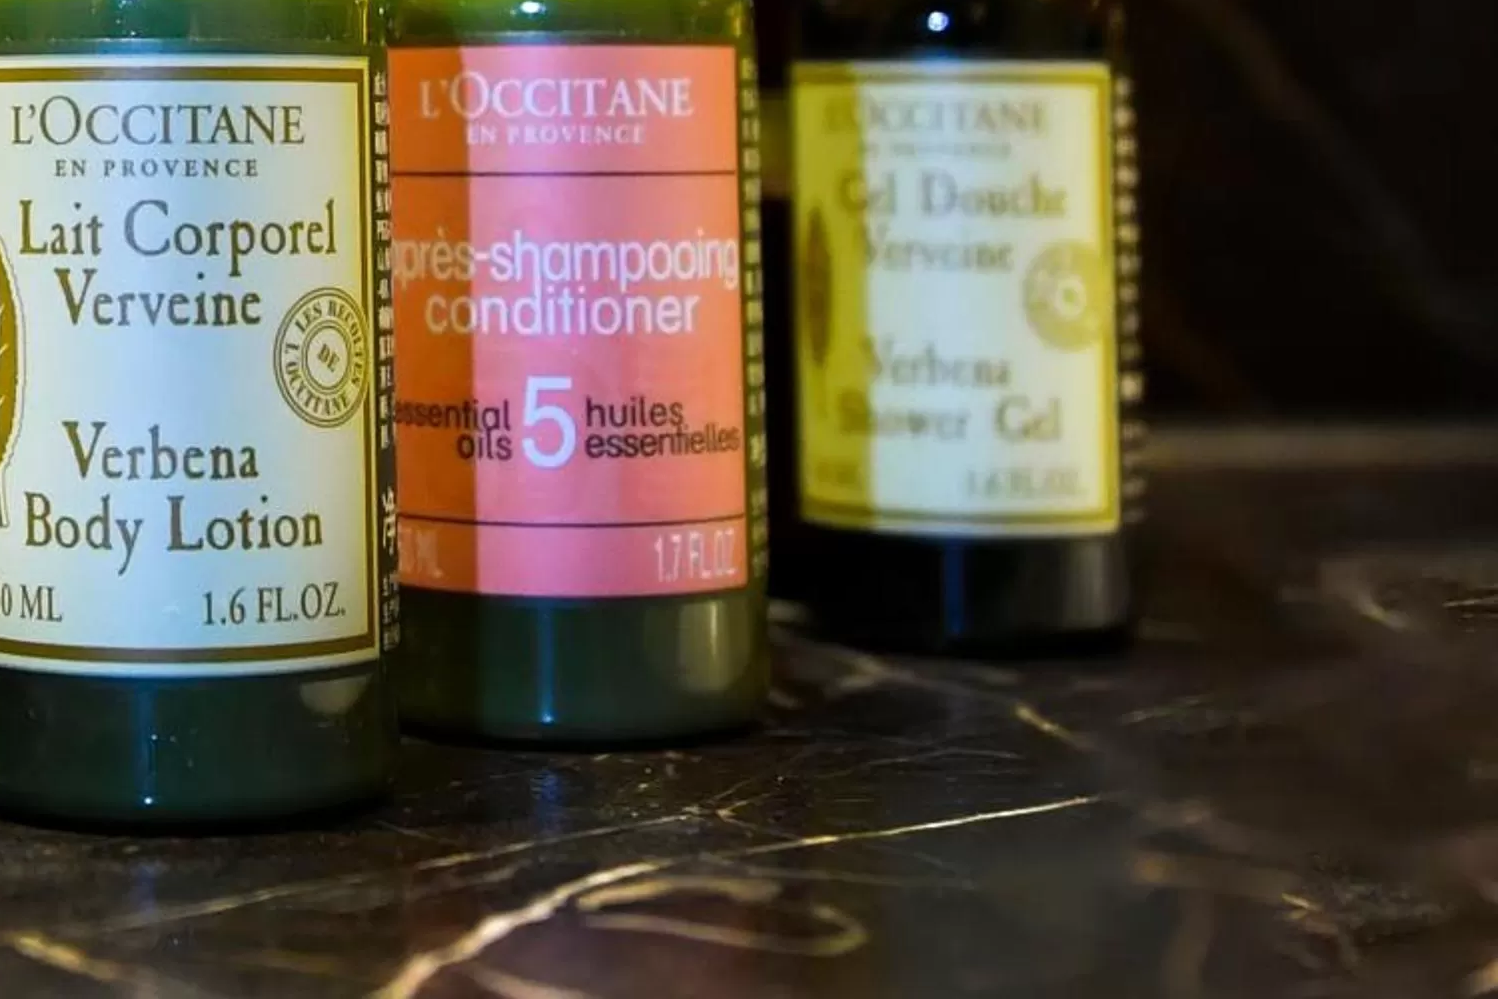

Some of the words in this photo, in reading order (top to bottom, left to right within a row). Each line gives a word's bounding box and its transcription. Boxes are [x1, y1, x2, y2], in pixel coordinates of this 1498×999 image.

[419, 71, 695, 118] L'OCCITANE
[12, 96, 305, 146] L'OCCITANE
[467, 124, 498, 145] EN
[507, 123, 646, 145] PROVENCE
[55, 159, 86, 178] EN
[103, 159, 260, 178] PROVENCE
[18, 200, 104, 256] Lait
[124, 198, 338, 277] Corporel
[54, 268, 262, 327] Verveine
[425, 286, 700, 336] conditioner
[522, 375, 577, 470] 5
[585, 395, 685, 428] huiles
[62, 420, 259, 480] Verbena
[456, 428, 513, 461] oils
[585, 422, 741, 459] essentielles
[23, 492, 144, 576] Body
[167, 495, 324, 551] Lotion
[20, 584, 63, 622] ML
[203, 585, 246, 625] 1.6
